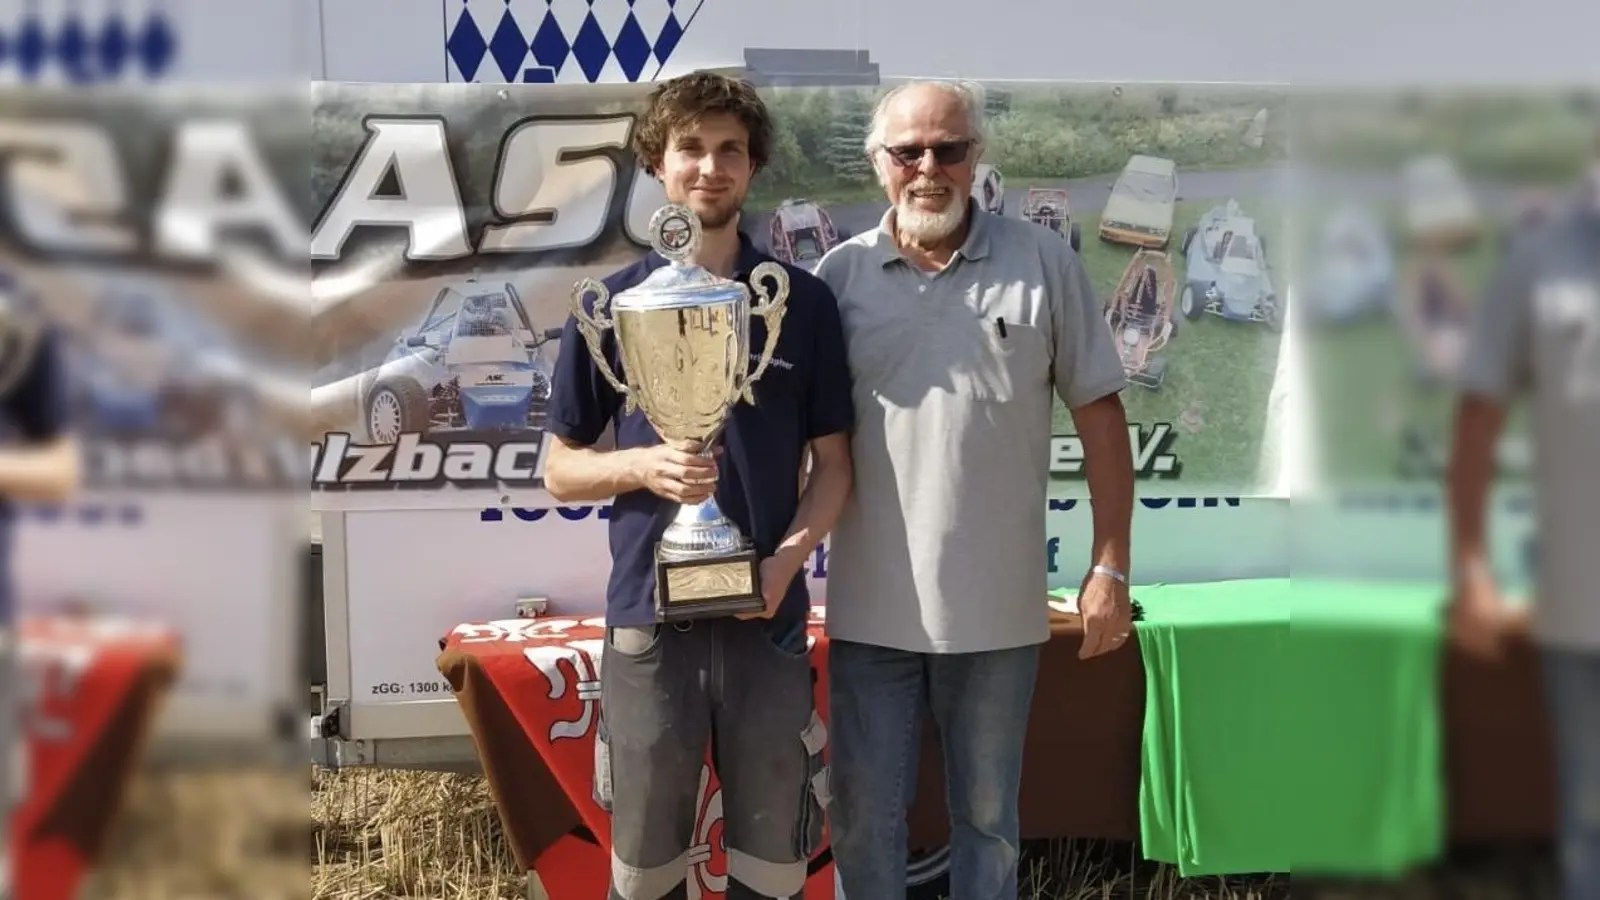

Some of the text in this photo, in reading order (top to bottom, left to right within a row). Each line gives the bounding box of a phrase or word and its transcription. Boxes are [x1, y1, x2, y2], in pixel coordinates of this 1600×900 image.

[372, 681, 453, 694] zGG: 1300 k
